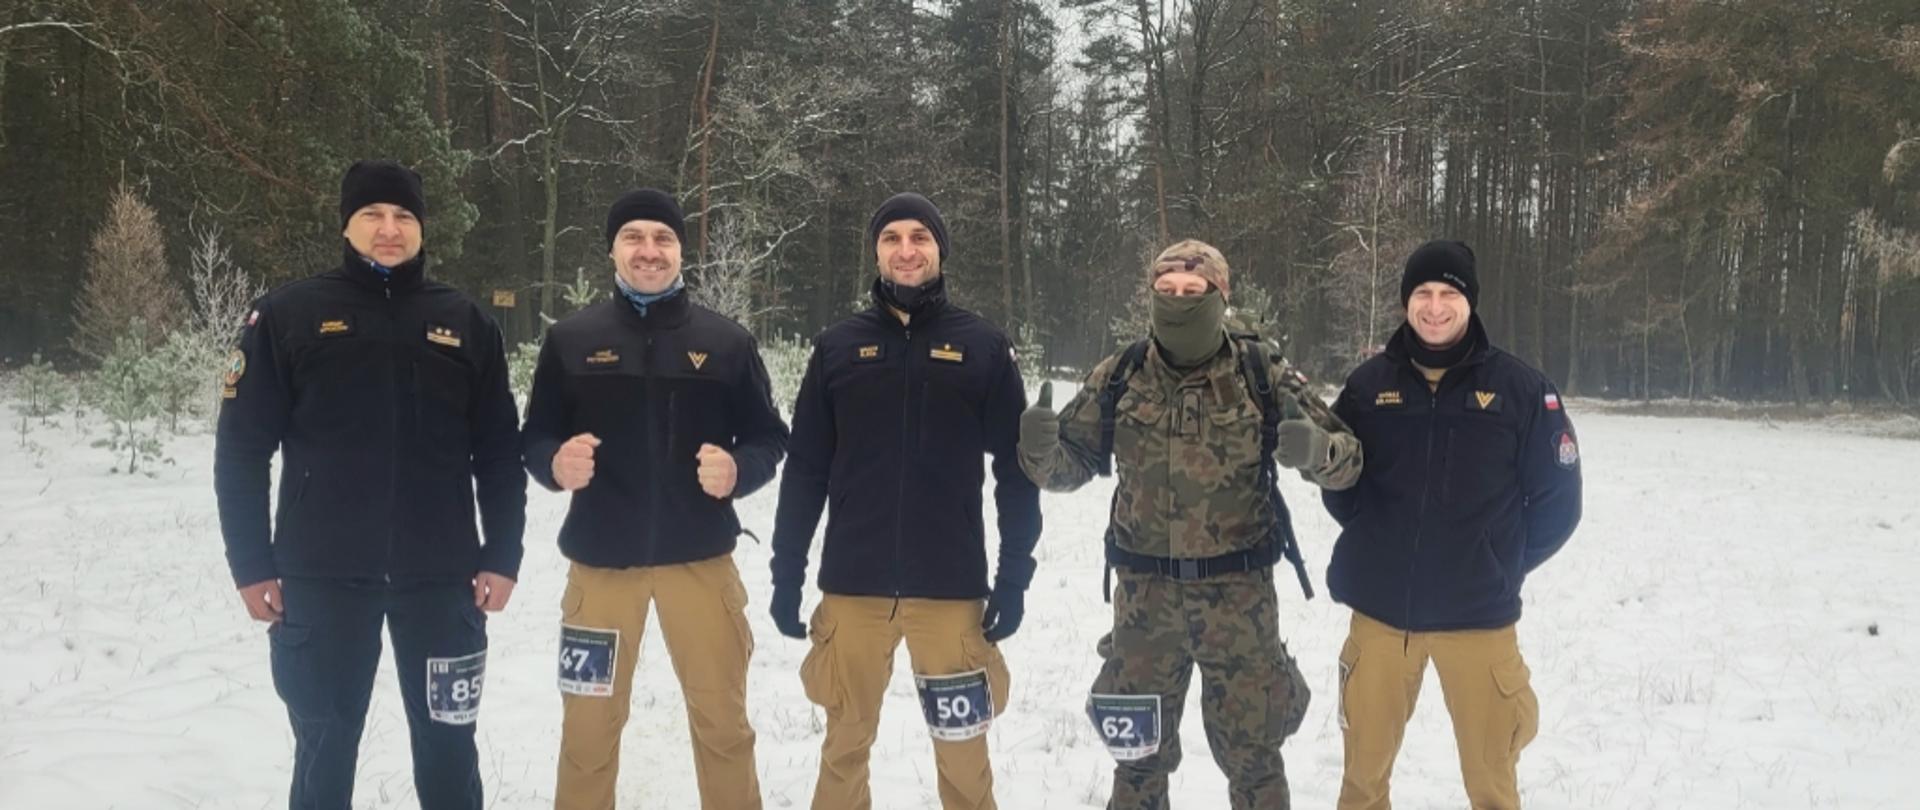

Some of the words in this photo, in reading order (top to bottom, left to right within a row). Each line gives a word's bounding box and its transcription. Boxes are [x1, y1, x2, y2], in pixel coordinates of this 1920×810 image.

[560, 647, 589, 672] 47
[451, 675, 484, 701] 85
[937, 695, 970, 719] 50
[1102, 716, 1135, 738] 62
